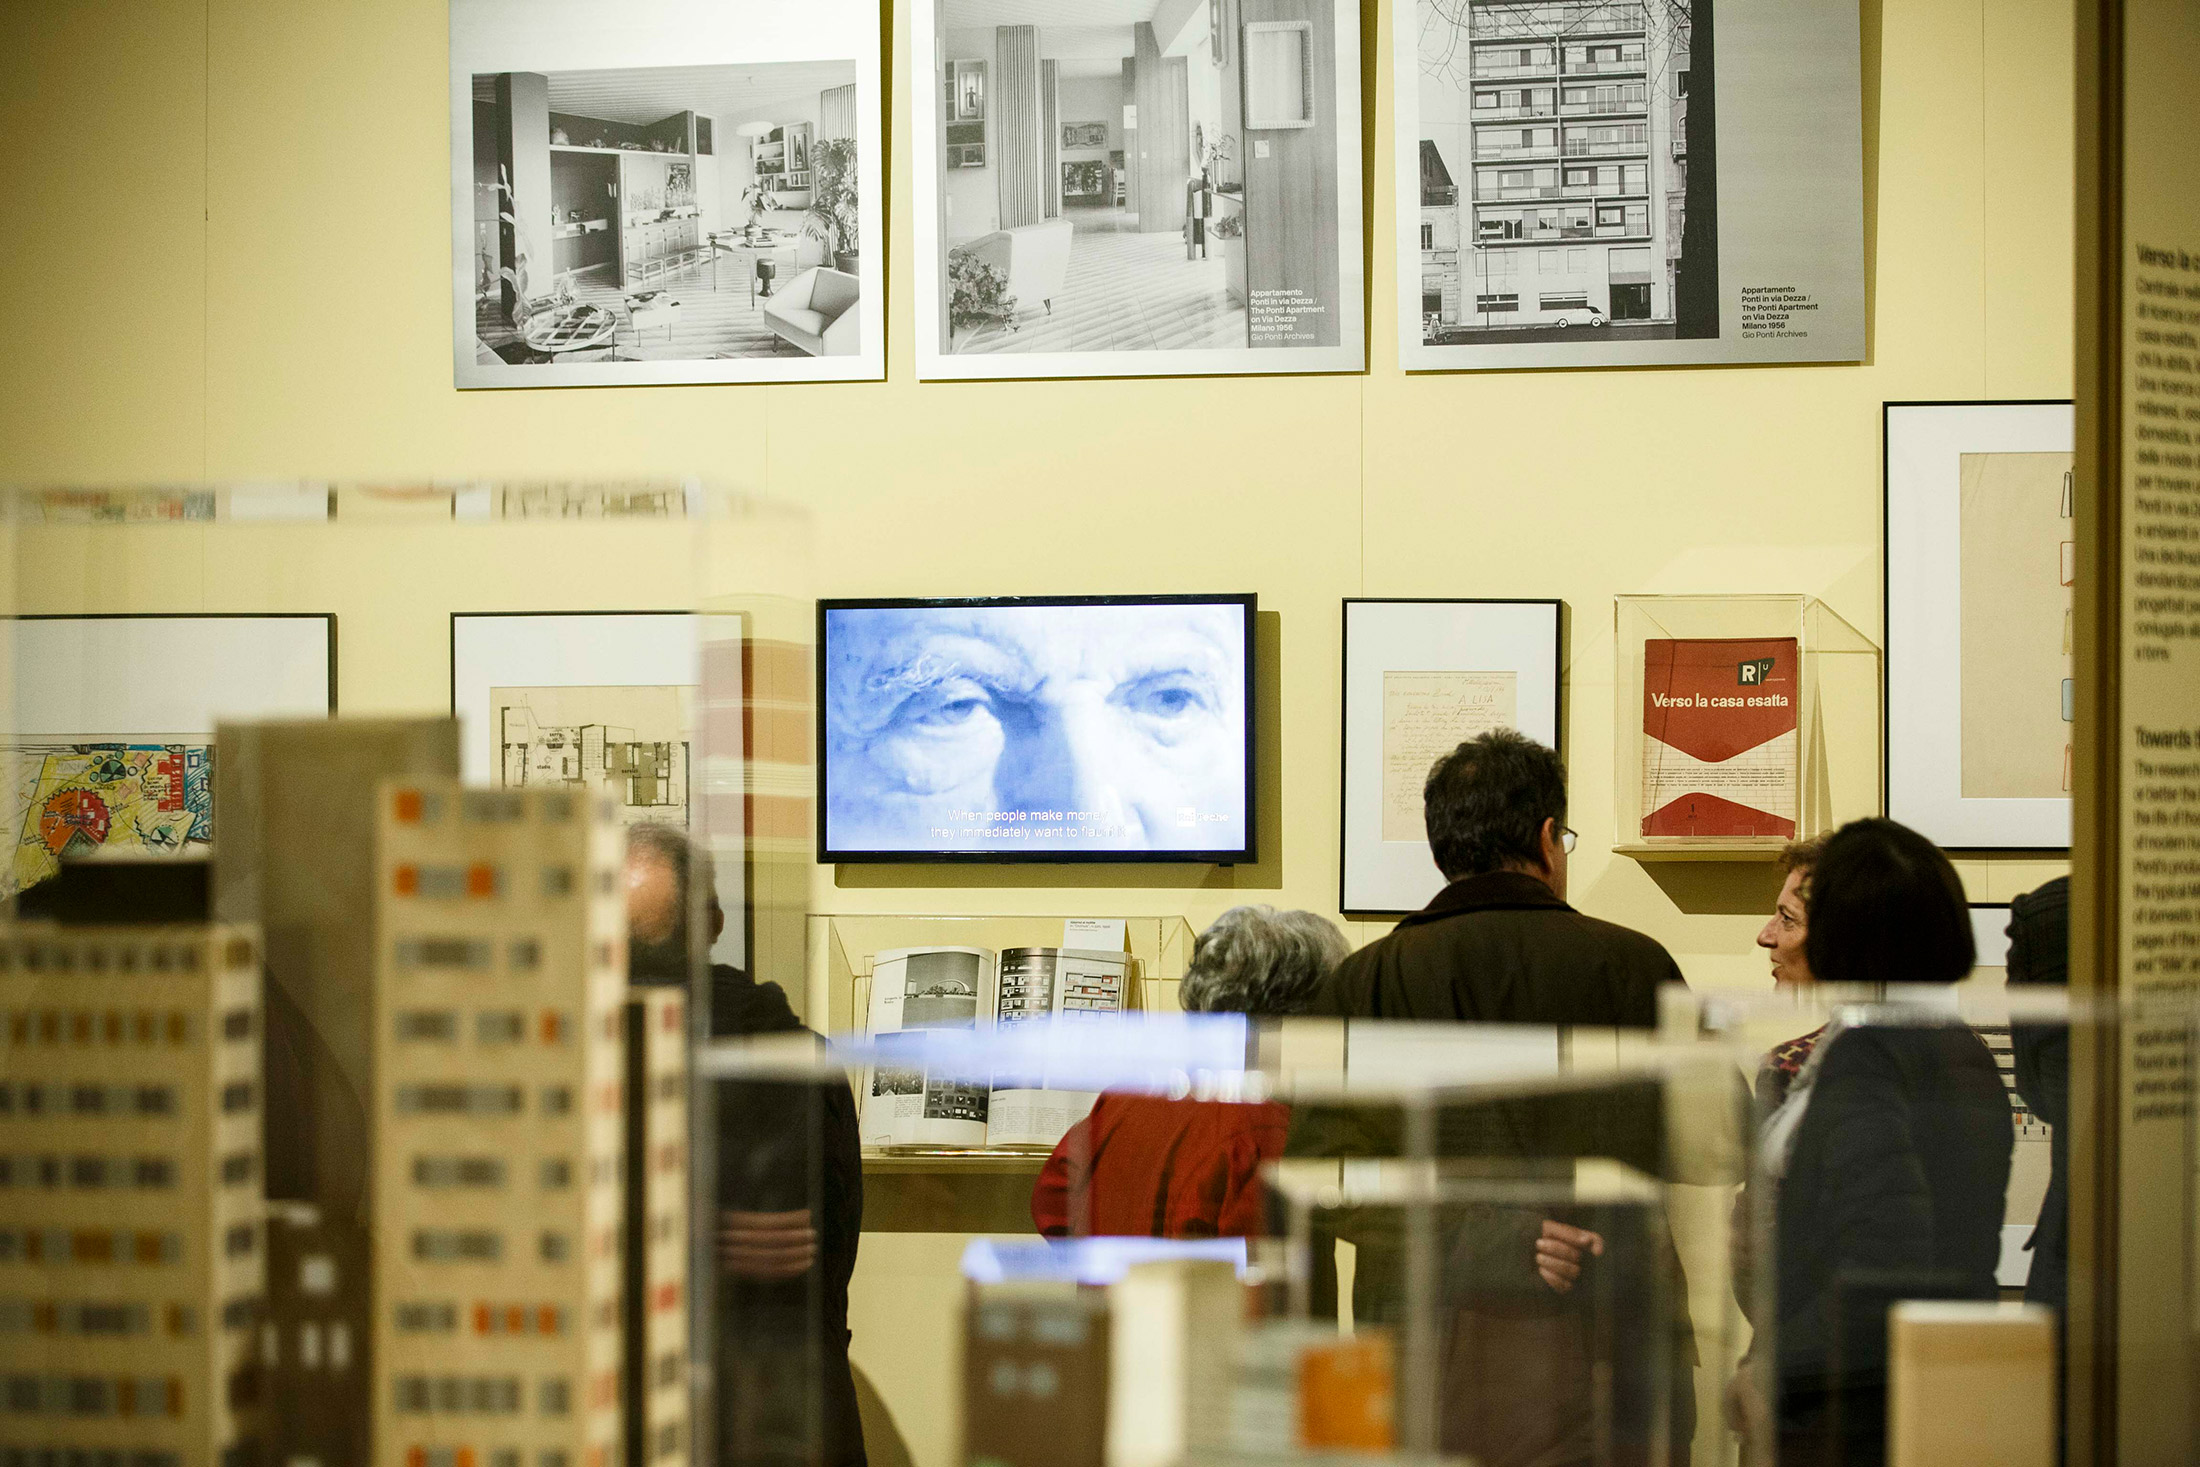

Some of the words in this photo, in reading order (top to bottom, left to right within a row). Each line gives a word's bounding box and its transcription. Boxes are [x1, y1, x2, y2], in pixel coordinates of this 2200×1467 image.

[1251, 289, 1303, 298] Appartamento
[1741, 286, 1796, 295] Appartamento
[1251, 306, 1265, 314] The
[1266, 306, 1285, 314] Ponti
[1286, 306, 1325, 315] Apartment
[1778, 303, 1818, 312] Apartment
[1275, 315, 1297, 323] Dezza
[1251, 324, 1275, 332] Milano
[1742, 322, 1767, 330] Milano
[1251, 333, 1263, 341] Gio
[1264, 332, 1283, 340] Ponti
[1284, 332, 1315, 340] Archives
[1742, 331, 1755, 339] Gio
[1776, 330, 1808, 338] Archives
[1652, 693, 1693, 708] Verso
[1696, 693, 1708, 708] la
[1711, 696, 1744, 708] casa
[1747, 693, 1788, 707] esatta
[948, 809, 983, 822] When
[986, 810, 1026, 825] people
[1030, 809, 1063, 821] make
[931, 826, 955, 840] they
[959, 826, 1029, 840] immediately
[1034, 827, 1063, 838] want
[1067, 827, 1078, 838] to
